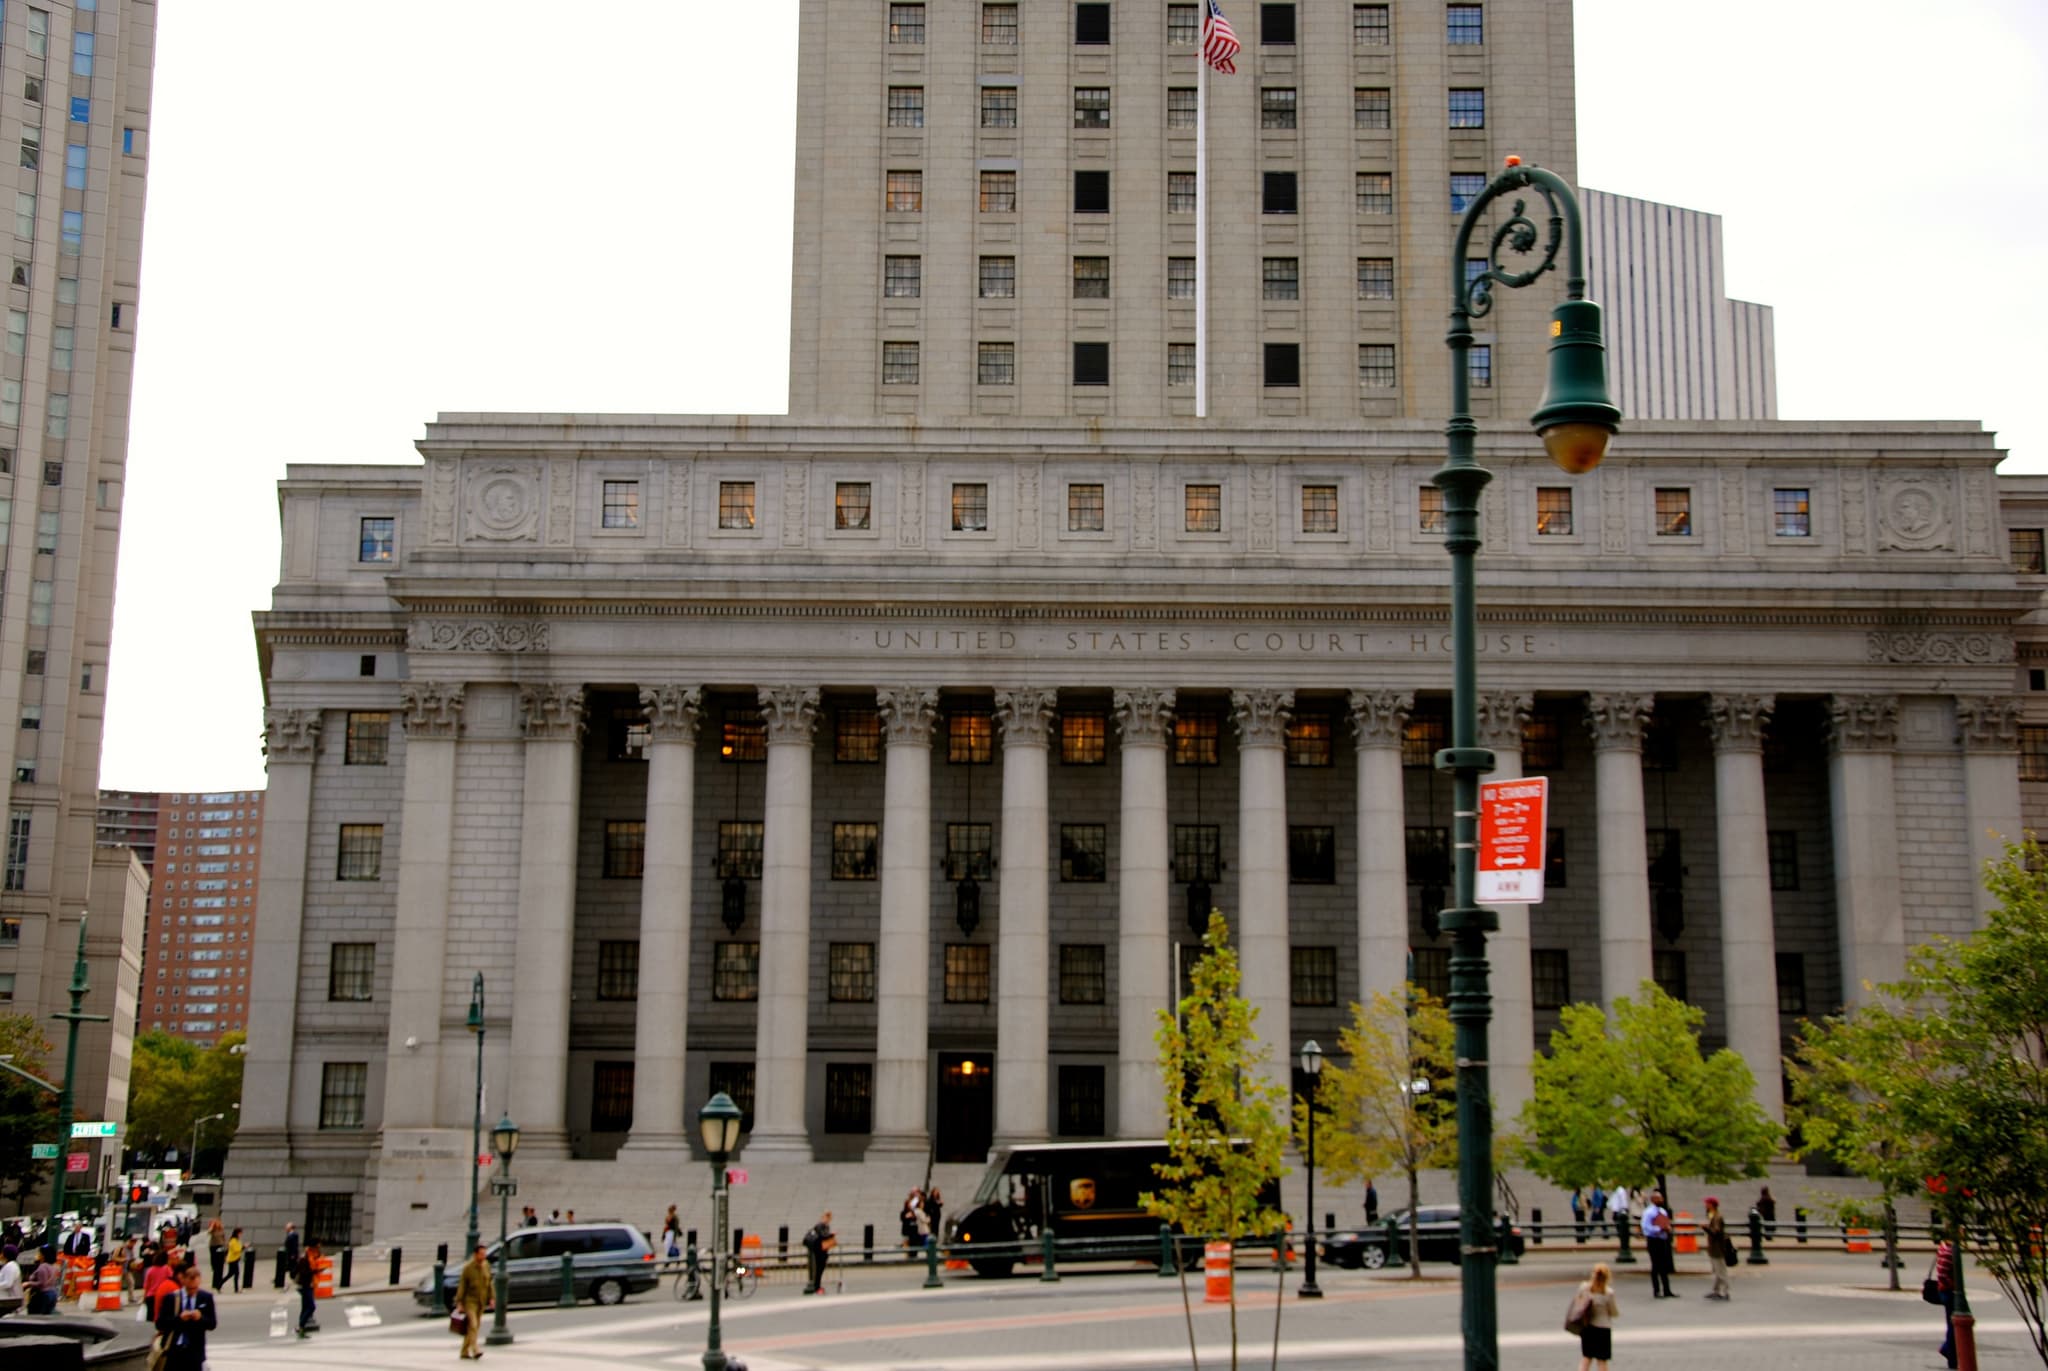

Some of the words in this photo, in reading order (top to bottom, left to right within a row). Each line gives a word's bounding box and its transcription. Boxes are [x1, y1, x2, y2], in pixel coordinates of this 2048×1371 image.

[875, 630, 1016, 649] UNITED
[1066, 631, 1191, 650] STATES
[1233, 632, 1369, 652] COURT
[1410, 633, 1536, 653] HOUSE
[1498, 785, 1541, 801] STANDING
